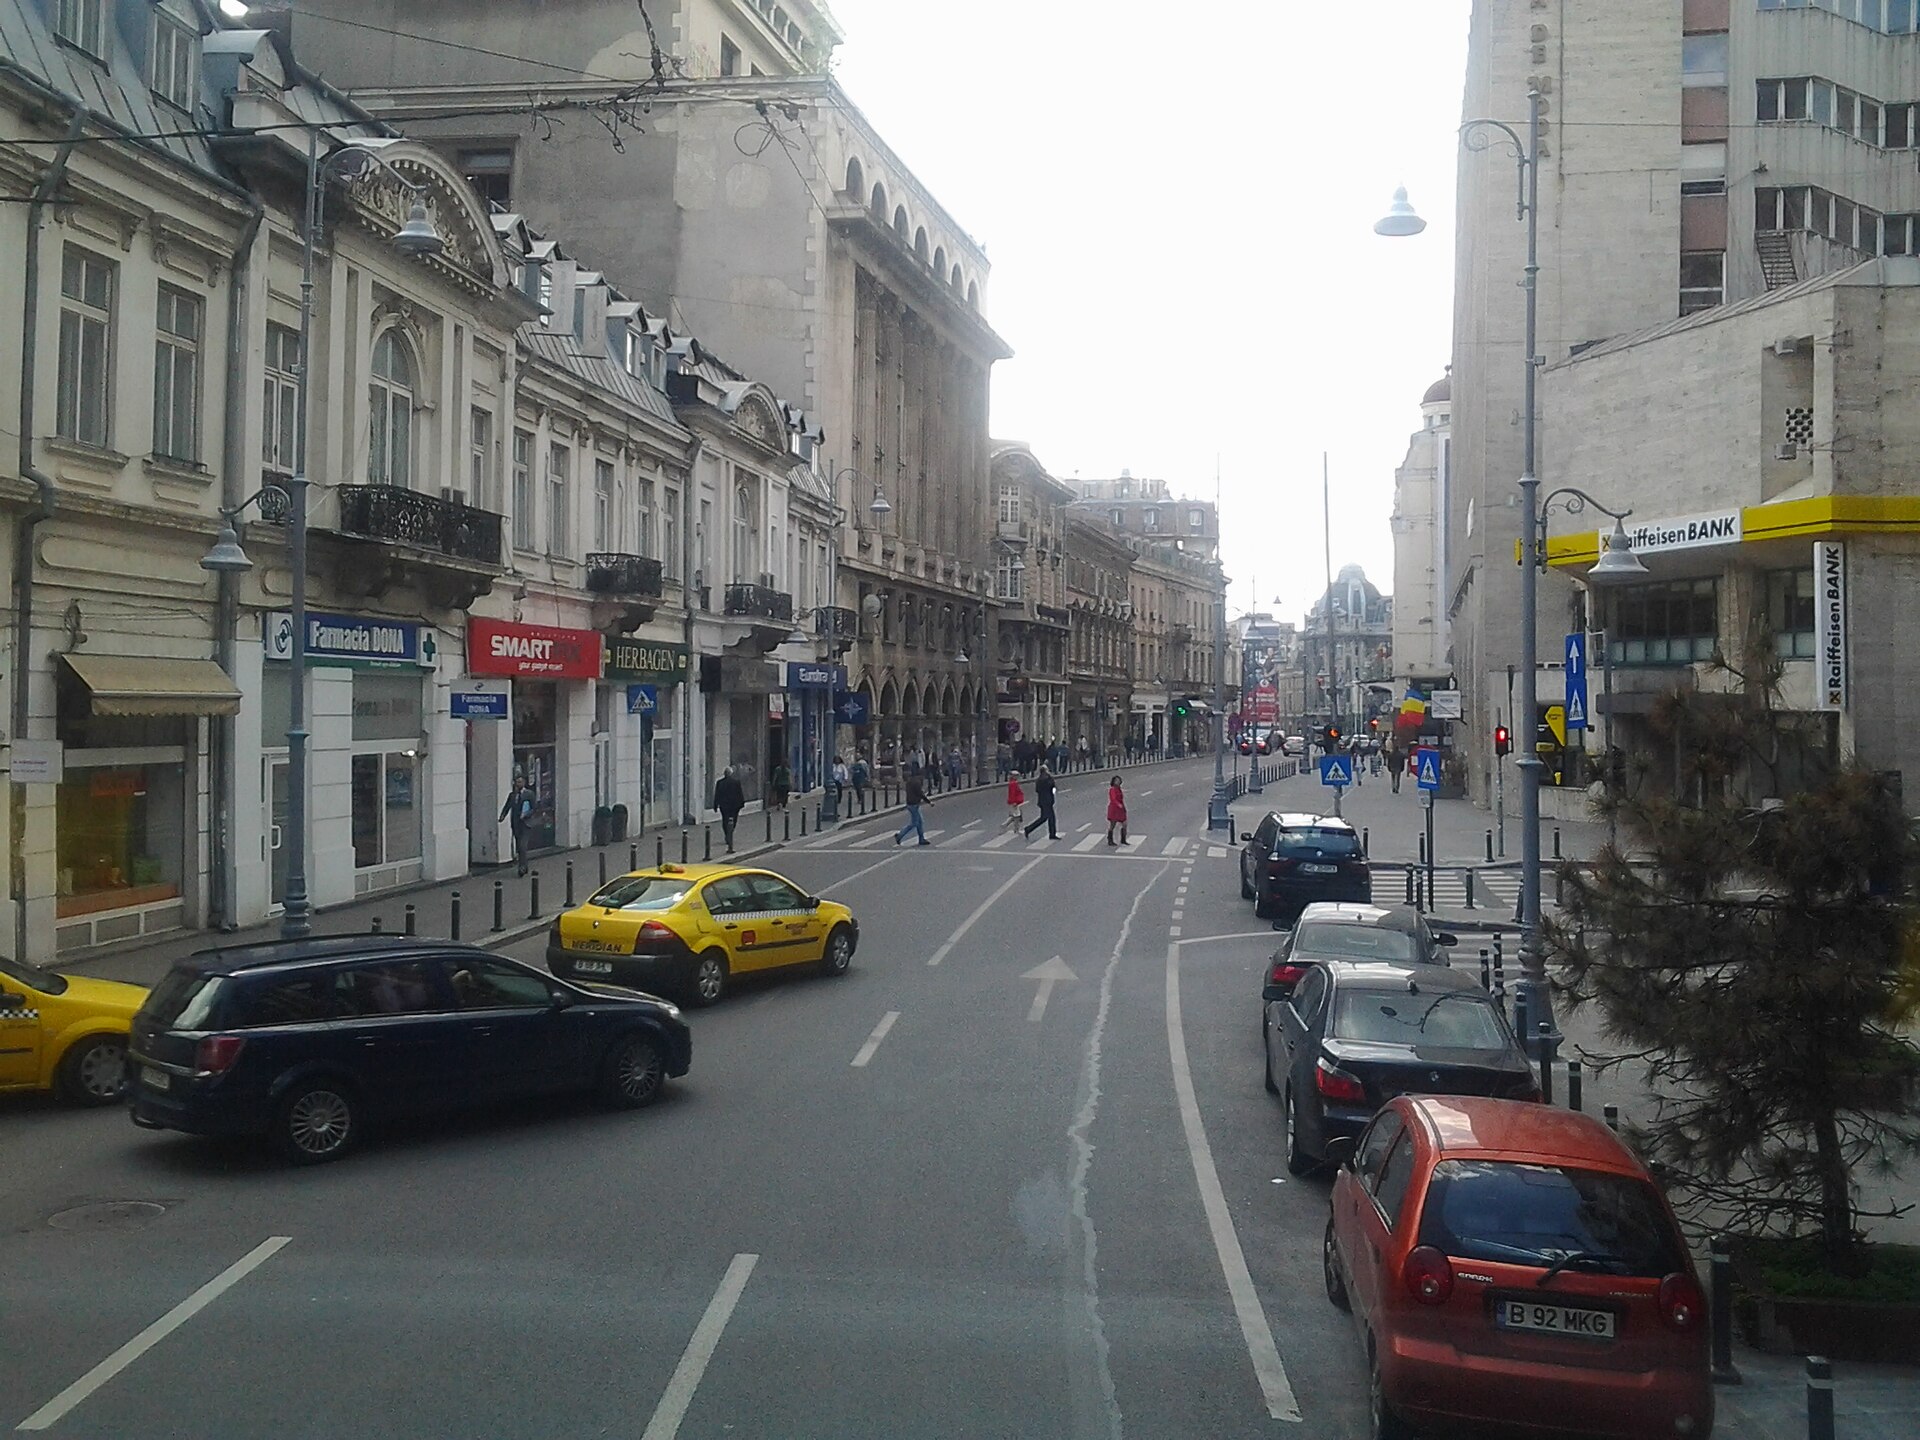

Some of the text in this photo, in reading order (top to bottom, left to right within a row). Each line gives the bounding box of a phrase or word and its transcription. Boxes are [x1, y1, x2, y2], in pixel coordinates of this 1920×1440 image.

[1626, 516, 1736, 549] aiffeisen BANK
[1825, 546, 1842, 690] Raiffeisen BANK
[309, 620, 370, 652] Farmacia
[490, 635, 554, 660] SMART
[616, 646, 675, 671] HERBAGEN
[1510, 1306, 1607, 1334] B 92 MKG
